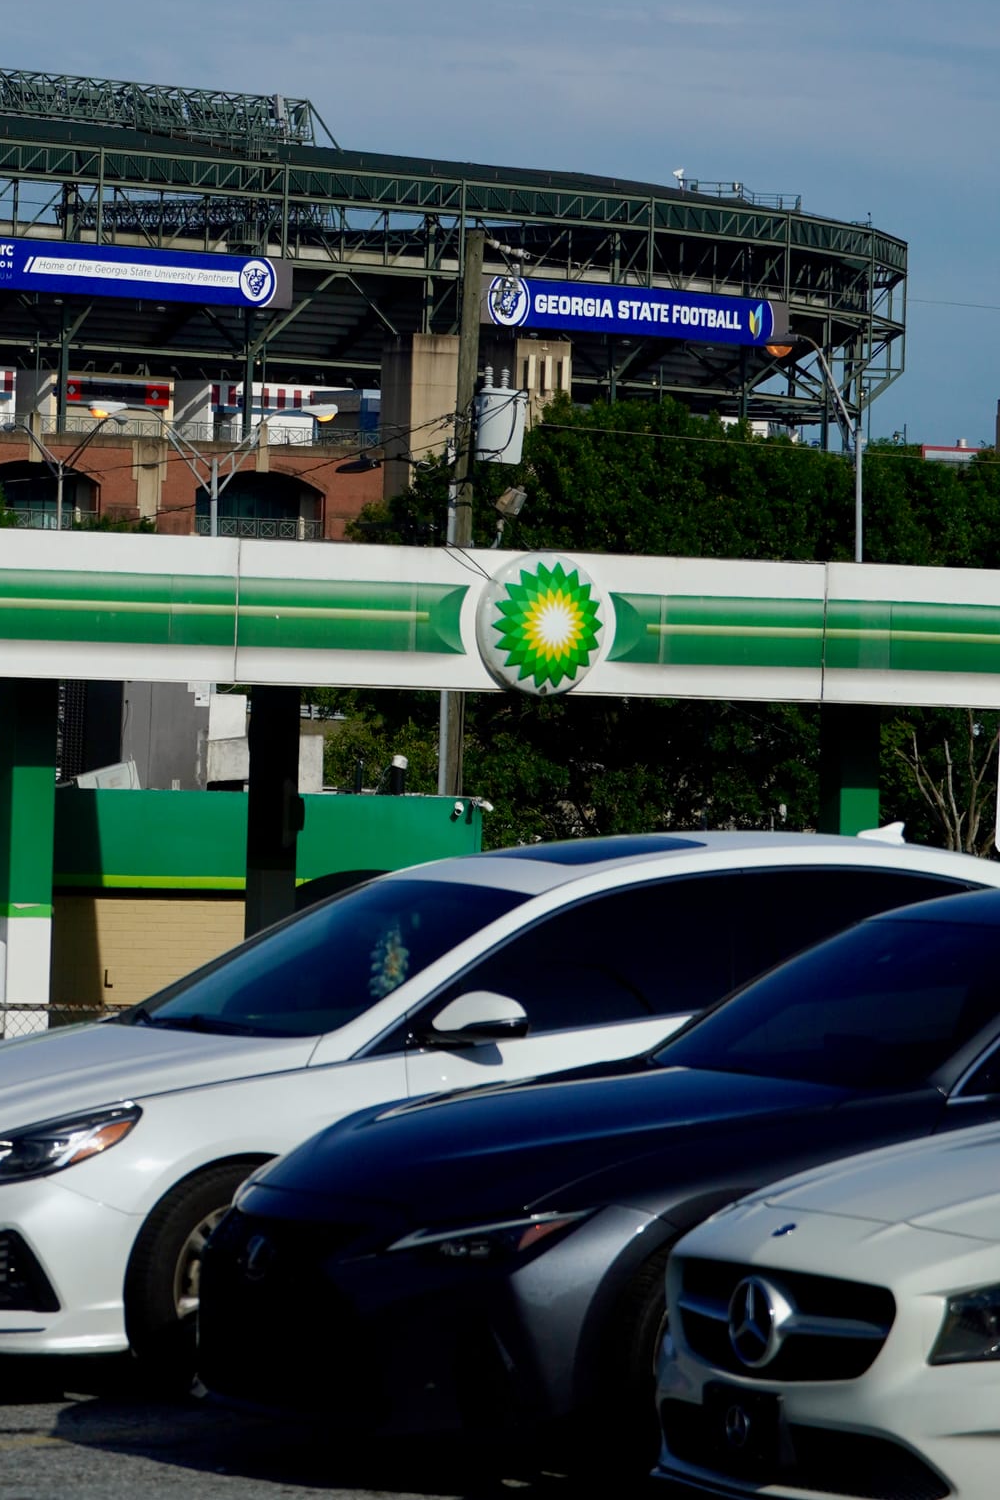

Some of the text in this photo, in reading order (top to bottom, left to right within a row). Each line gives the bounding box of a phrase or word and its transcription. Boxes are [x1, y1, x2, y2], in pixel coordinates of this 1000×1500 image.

[38, 260, 234, 284] Home of the Georgia State University Panthers
[534, 294, 742, 330] GEORGIA STATE FOOTBALL
